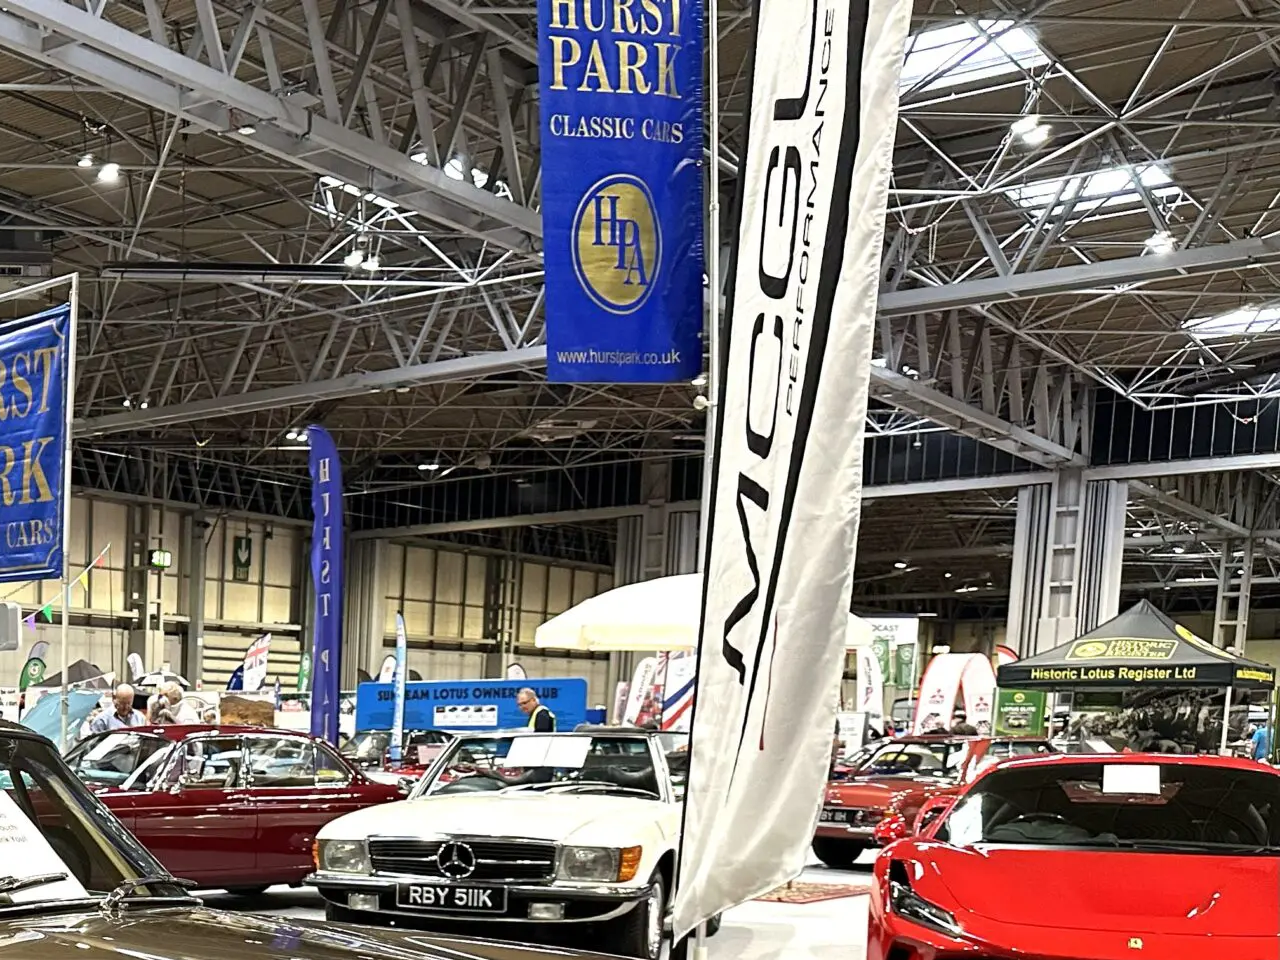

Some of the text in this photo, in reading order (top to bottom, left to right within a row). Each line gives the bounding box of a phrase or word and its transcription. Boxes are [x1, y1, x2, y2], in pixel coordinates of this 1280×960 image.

[549, 36, 683, 99] PARK
[549, 114, 684, 144] CLASSIC CARS
[785, 8, 835, 417] PERFORMANCE
[557, 348, 681, 367] www.hurstpark.co.uk
[6, 518, 55, 549] CARS
[1031, 667, 1197, 682] Historic Lotus Register Ltd
[377, 688, 430, 701] SUNEAM
[433, 687, 469, 700] LOTUS
[409, 885, 493, 907] RBY 511K
